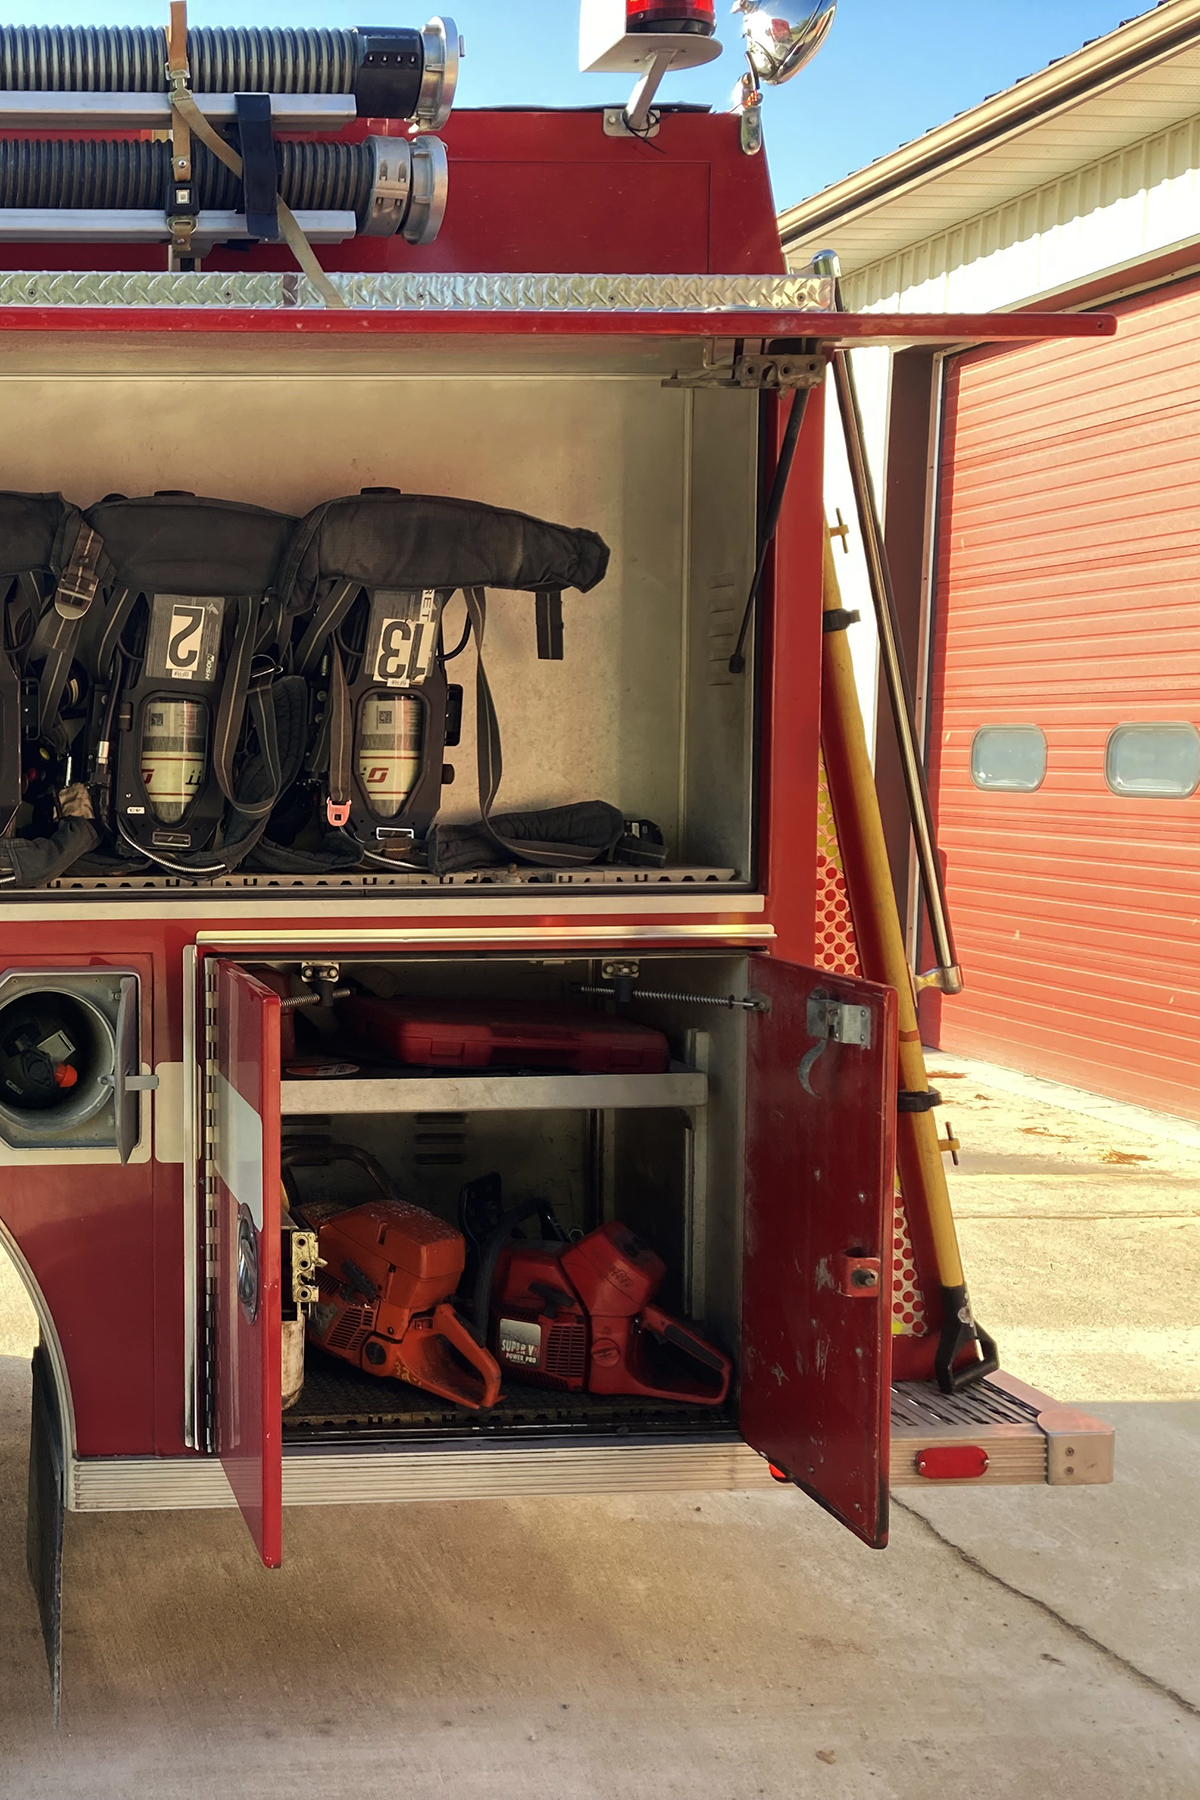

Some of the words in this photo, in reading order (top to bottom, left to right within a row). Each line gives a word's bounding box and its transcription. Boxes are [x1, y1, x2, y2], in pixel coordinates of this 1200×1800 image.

[169, 607, 203, 668] 2
[380, 620, 426, 681] 13
[204, 653, 215, 680] NIOSH
[505, 1352, 524, 1361] POWER
